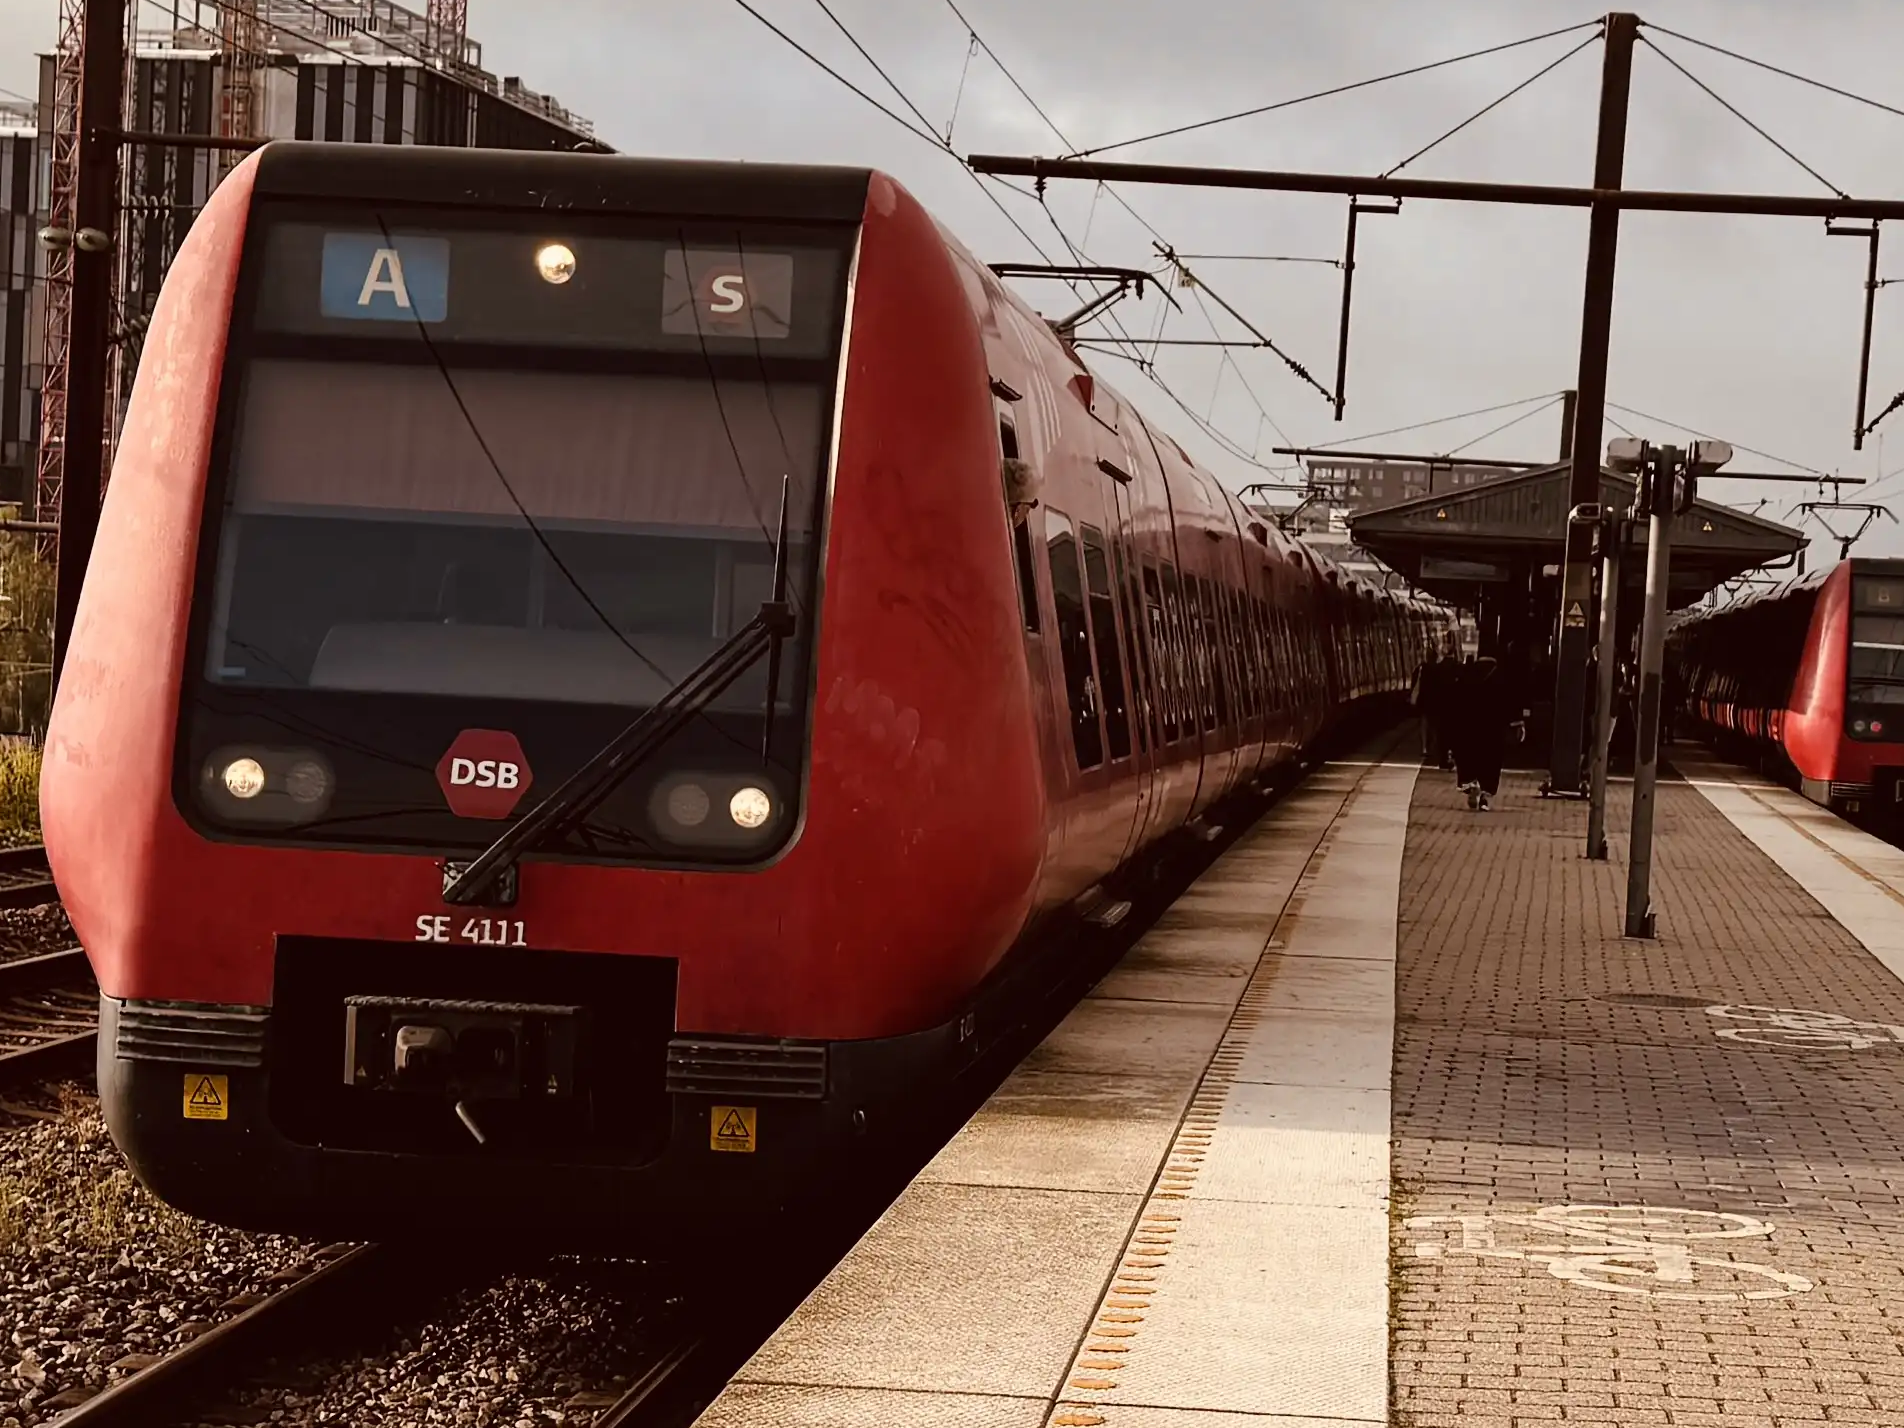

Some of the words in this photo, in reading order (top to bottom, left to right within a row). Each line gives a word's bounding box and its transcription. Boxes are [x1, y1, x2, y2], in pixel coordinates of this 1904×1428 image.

[357, 248, 411, 308] A
[710, 275, 744, 313] S
[450, 758, 520, 789] DSB
[415, 915, 451, 943] SE
[461, 918, 528, 947] 4111
